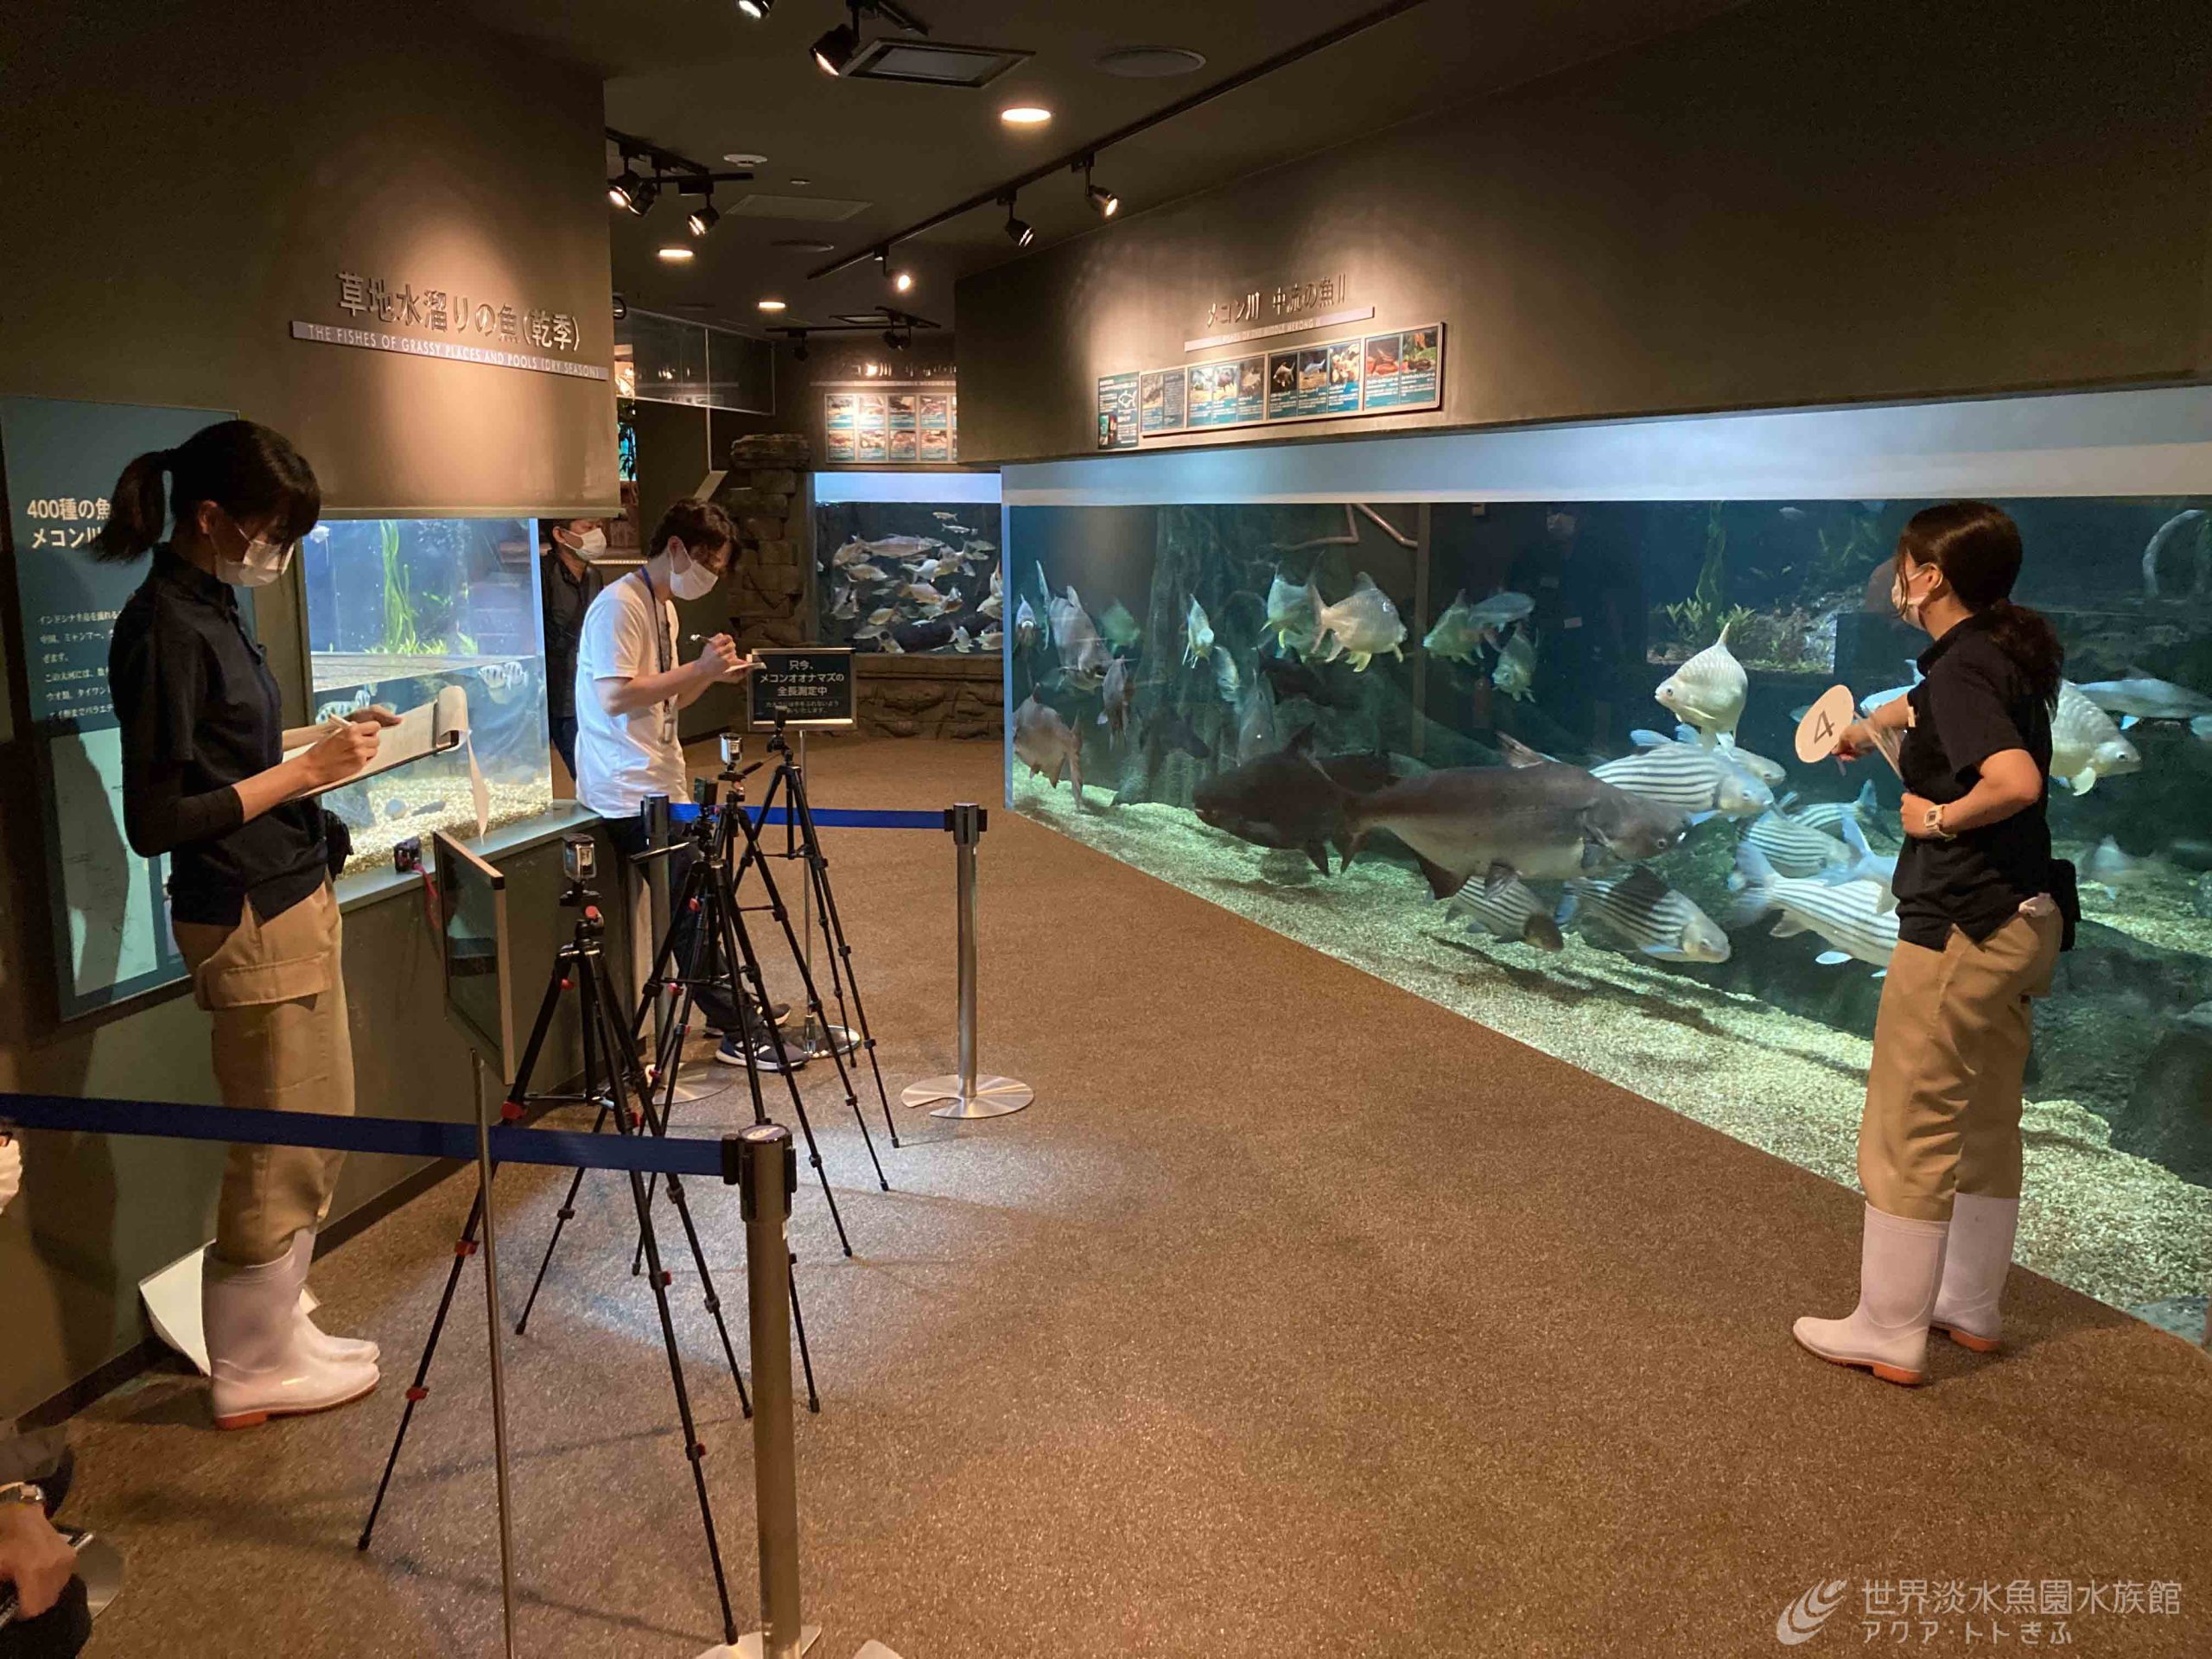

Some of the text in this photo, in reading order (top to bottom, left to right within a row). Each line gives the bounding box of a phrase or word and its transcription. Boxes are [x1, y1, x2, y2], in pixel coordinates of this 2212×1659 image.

[337, 271, 580, 352] 草地水溜りの魚(乾季)
[1206, 291, 1262, 328] メコン川
[1287, 319, 1313, 333] MEKONG
[308, 325, 333, 342] THE
[337, 328, 376, 347] FISHES
[381, 334, 397, 347] OF
[401, 338, 441, 356] GRASSY
[445, 345, 481, 361] PLACES
[484, 352, 505, 366] AND
[507, 355, 538, 371] POOLS
[27, 498, 111, 520] 400種の魚
[40, 610, 121, 624] インドシナ半島を流れる
[789, 659, 814, 671] 只今、
[760, 672, 845, 683] メコンオオナマズの
[778, 686, 828, 697] 全長測定中
[1814, 710, 1834, 744] 4
